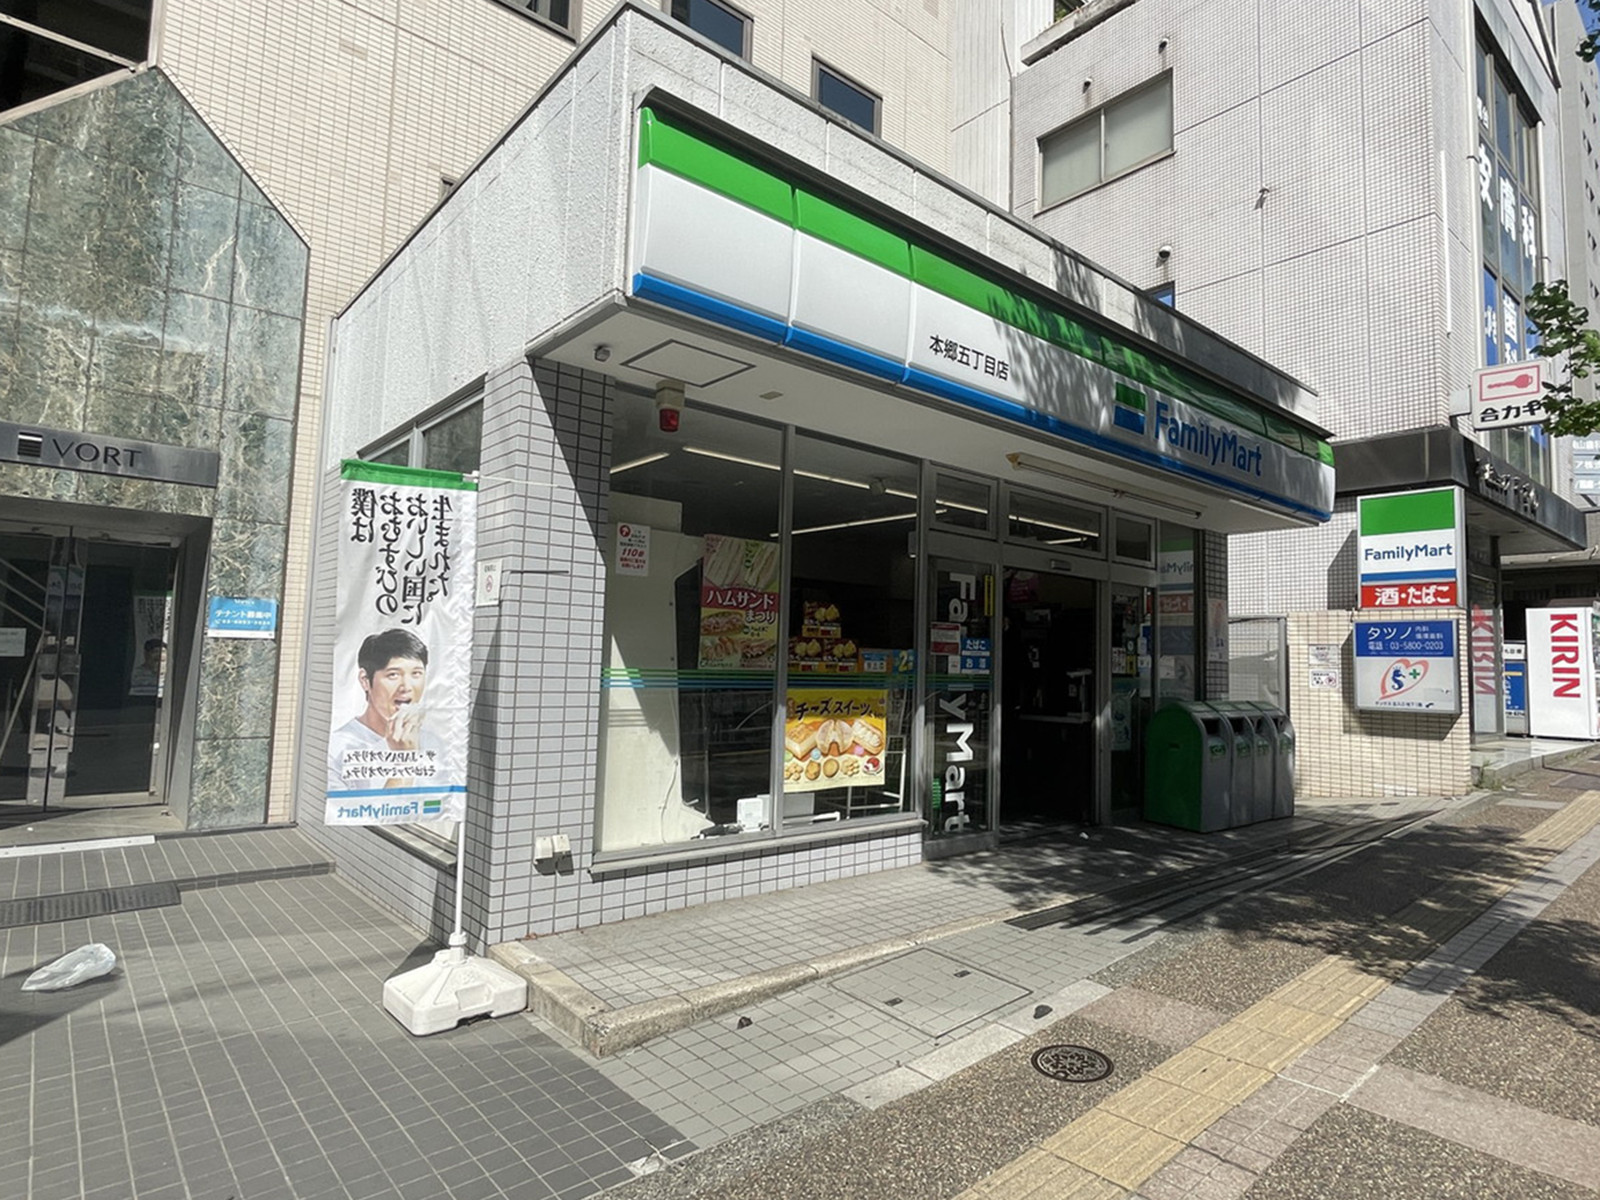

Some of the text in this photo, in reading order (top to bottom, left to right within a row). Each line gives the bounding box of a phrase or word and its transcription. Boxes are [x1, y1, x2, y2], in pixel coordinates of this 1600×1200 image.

[929, 334, 1009, 382] 本郷五丁目店
[1154, 401, 1262, 478] FamilyMart
[52, 438, 142, 468] VORT
[1364, 542, 1453, 562] FamilyMart
[706, 590, 774, 610] ハムサンド
[1374, 584, 1451, 606] 酒・たばこ
[745, 610, 776, 625] まつり
[1367, 626, 1412, 640] タツノ
[1550, 613, 1581, 698] KIRIN
[795, 696, 872, 720] チーズスイーツ
